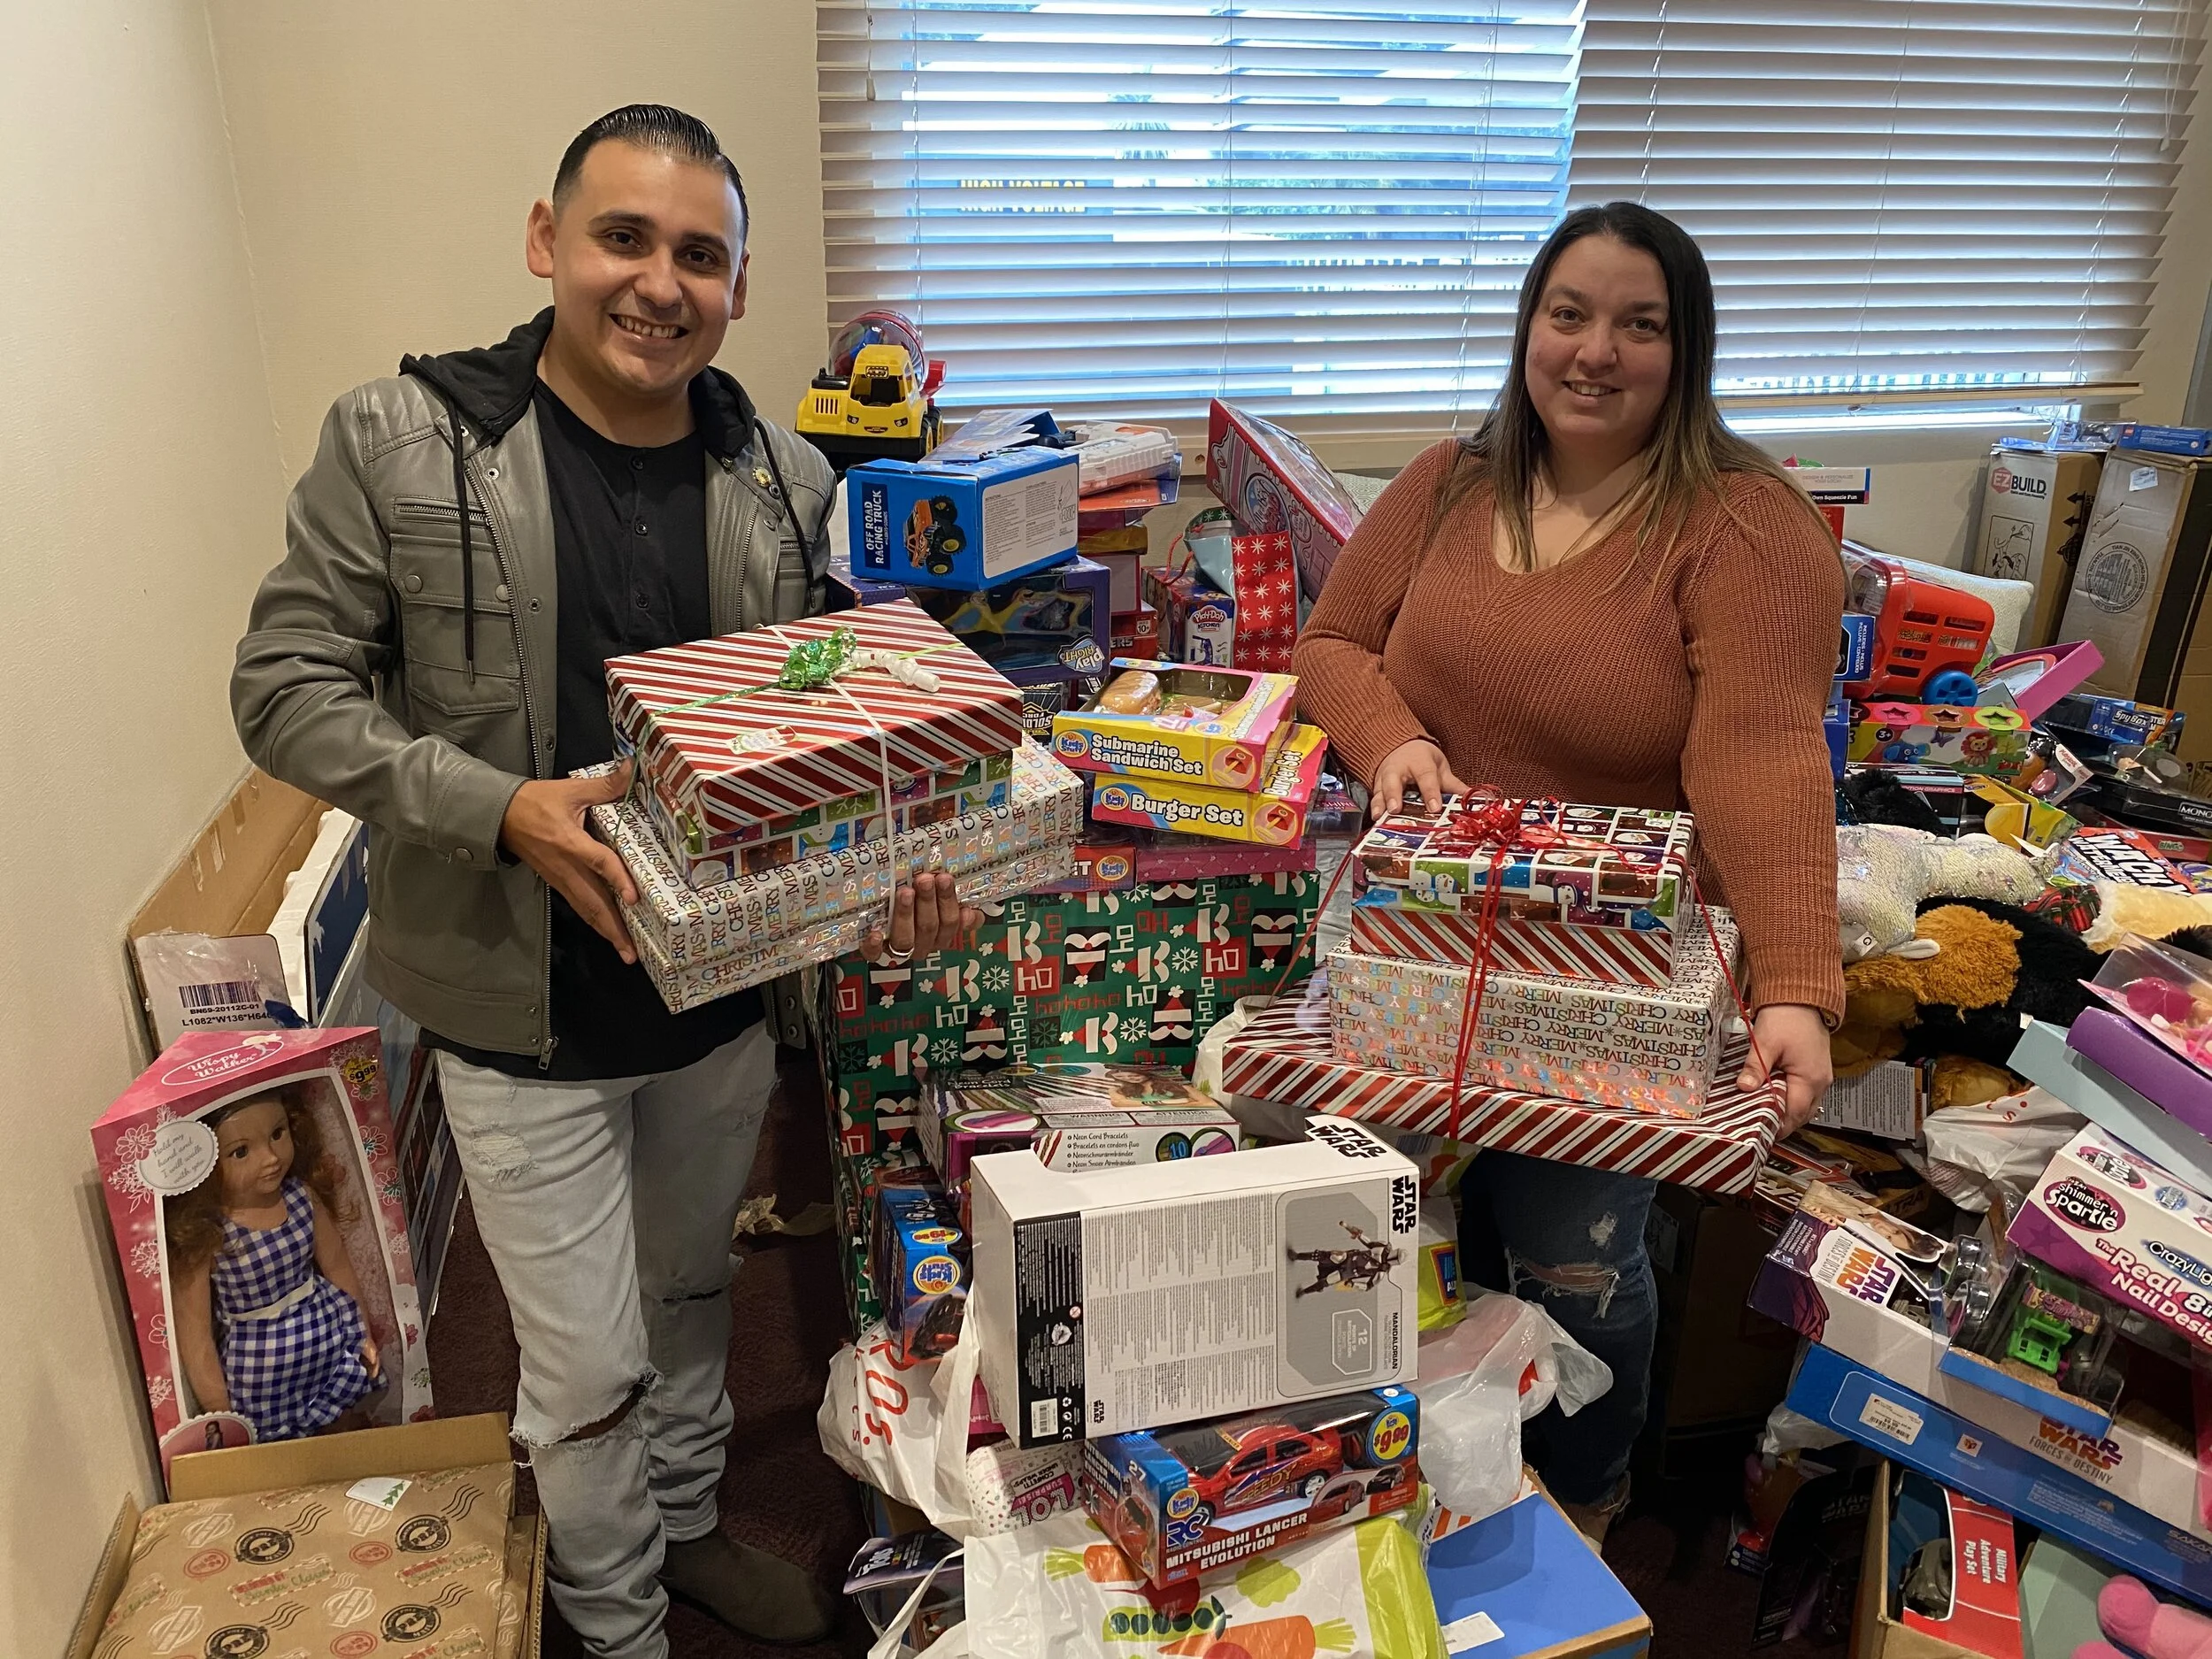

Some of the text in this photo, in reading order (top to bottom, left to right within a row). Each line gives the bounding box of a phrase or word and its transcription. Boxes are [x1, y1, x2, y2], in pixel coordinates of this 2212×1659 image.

[2011, 475, 2047, 494] BUILD
[864, 501, 875, 550] OFF ROAD
[872, 489, 884, 565] RACING TRUCK
[1110, 636, 1133, 649] ERS
[1137, 625, 1150, 634] 10+
[1064, 644, 1099, 663] RIGHT
[1075, 646, 1105, 670] play
[1023, 714, 1053, 728] SOLDI
[1878, 730, 1892, 739] 3+
[1090, 733, 1179, 759] Submarine
[1090, 748, 1203, 776] Sandwich Set
[1262, 766, 1302, 796] Burger
[1131, 794, 1244, 827] Burger Set
[1206, 947, 1240, 972] ho
[1018, 965, 1053, 991] ho
[1126, 983, 1158, 1007] ho
[936, 1004, 970, 1028] ho
[1072, 1141, 1098, 1150] Bracelets
[1103, 1132, 1128, 1141] Bracelets
[1169, 1141, 1187, 1158] 10
[1310, 1125, 1371, 1159] WARS
[1328, 1124, 1387, 1157] STAR
[1072, 1160, 1087, 1169] Neon
[1392, 1175, 1404, 1235] WARS
[1404, 1175, 1417, 1234] STAR
[2046, 1188, 2118, 1232] Sparkle
[2059, 1183, 2108, 1211] shimmer
[1836, 1247, 1878, 1296] WARS
[1858, 1256, 1896, 1304] STAR
[2097, 1239, 2117, 1255] The
[2111, 1247, 2182, 1298] Real
[2111, 1272, 2160, 1309] Nail
[1357, 1328, 1368, 1345] 12
[2029, 1436, 2064, 1461] FORCES
[2073, 1459, 2114, 1485] DESTINY
[2039, 1421, 2124, 1471] WARS
[1085, 1460, 1118, 1499] EVOLUTION
[1128, 1460, 1147, 1481] 27
[1166, 1514, 1204, 1548] RC
[1166, 1512, 1308, 1569] MITSUBISHI LANCER
[1200, 1536, 1275, 1570] EVOLUTION
[1963, 1540, 1978, 1575] Play Set
[1980, 1538, 1993, 1584] Adventure
[1995, 1548, 2008, 1583] Military
